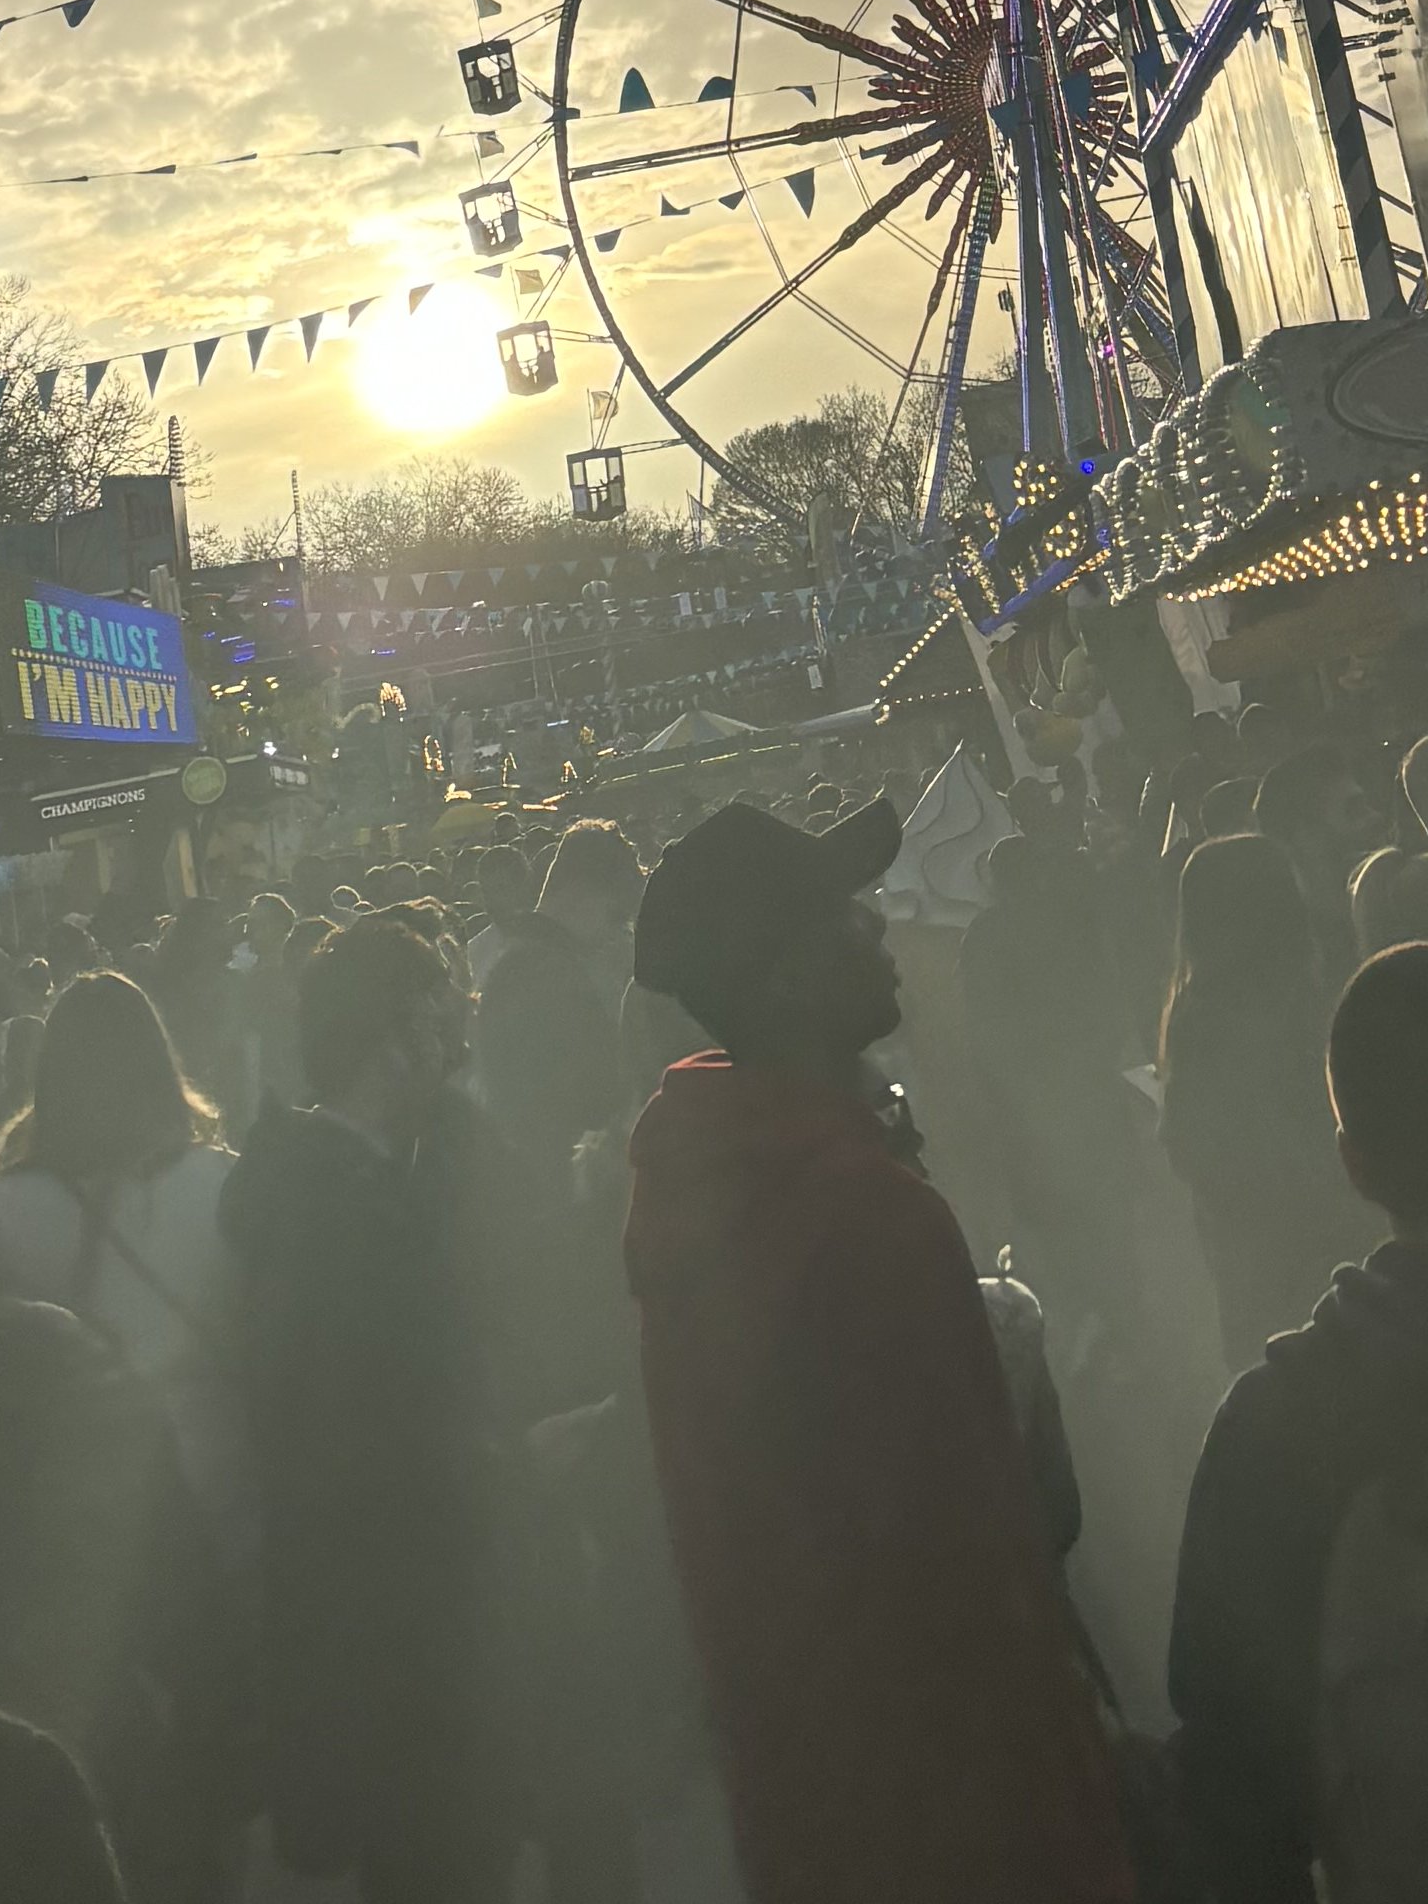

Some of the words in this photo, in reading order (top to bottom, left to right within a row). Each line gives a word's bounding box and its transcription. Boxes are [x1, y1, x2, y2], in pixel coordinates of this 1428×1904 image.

[25, 599, 163, 671] BECAUSE
[17, 661, 82, 725] I'M
[85, 671, 178, 732] HAPPY
[41, 788, 146, 819] CHAMPIGNONS
